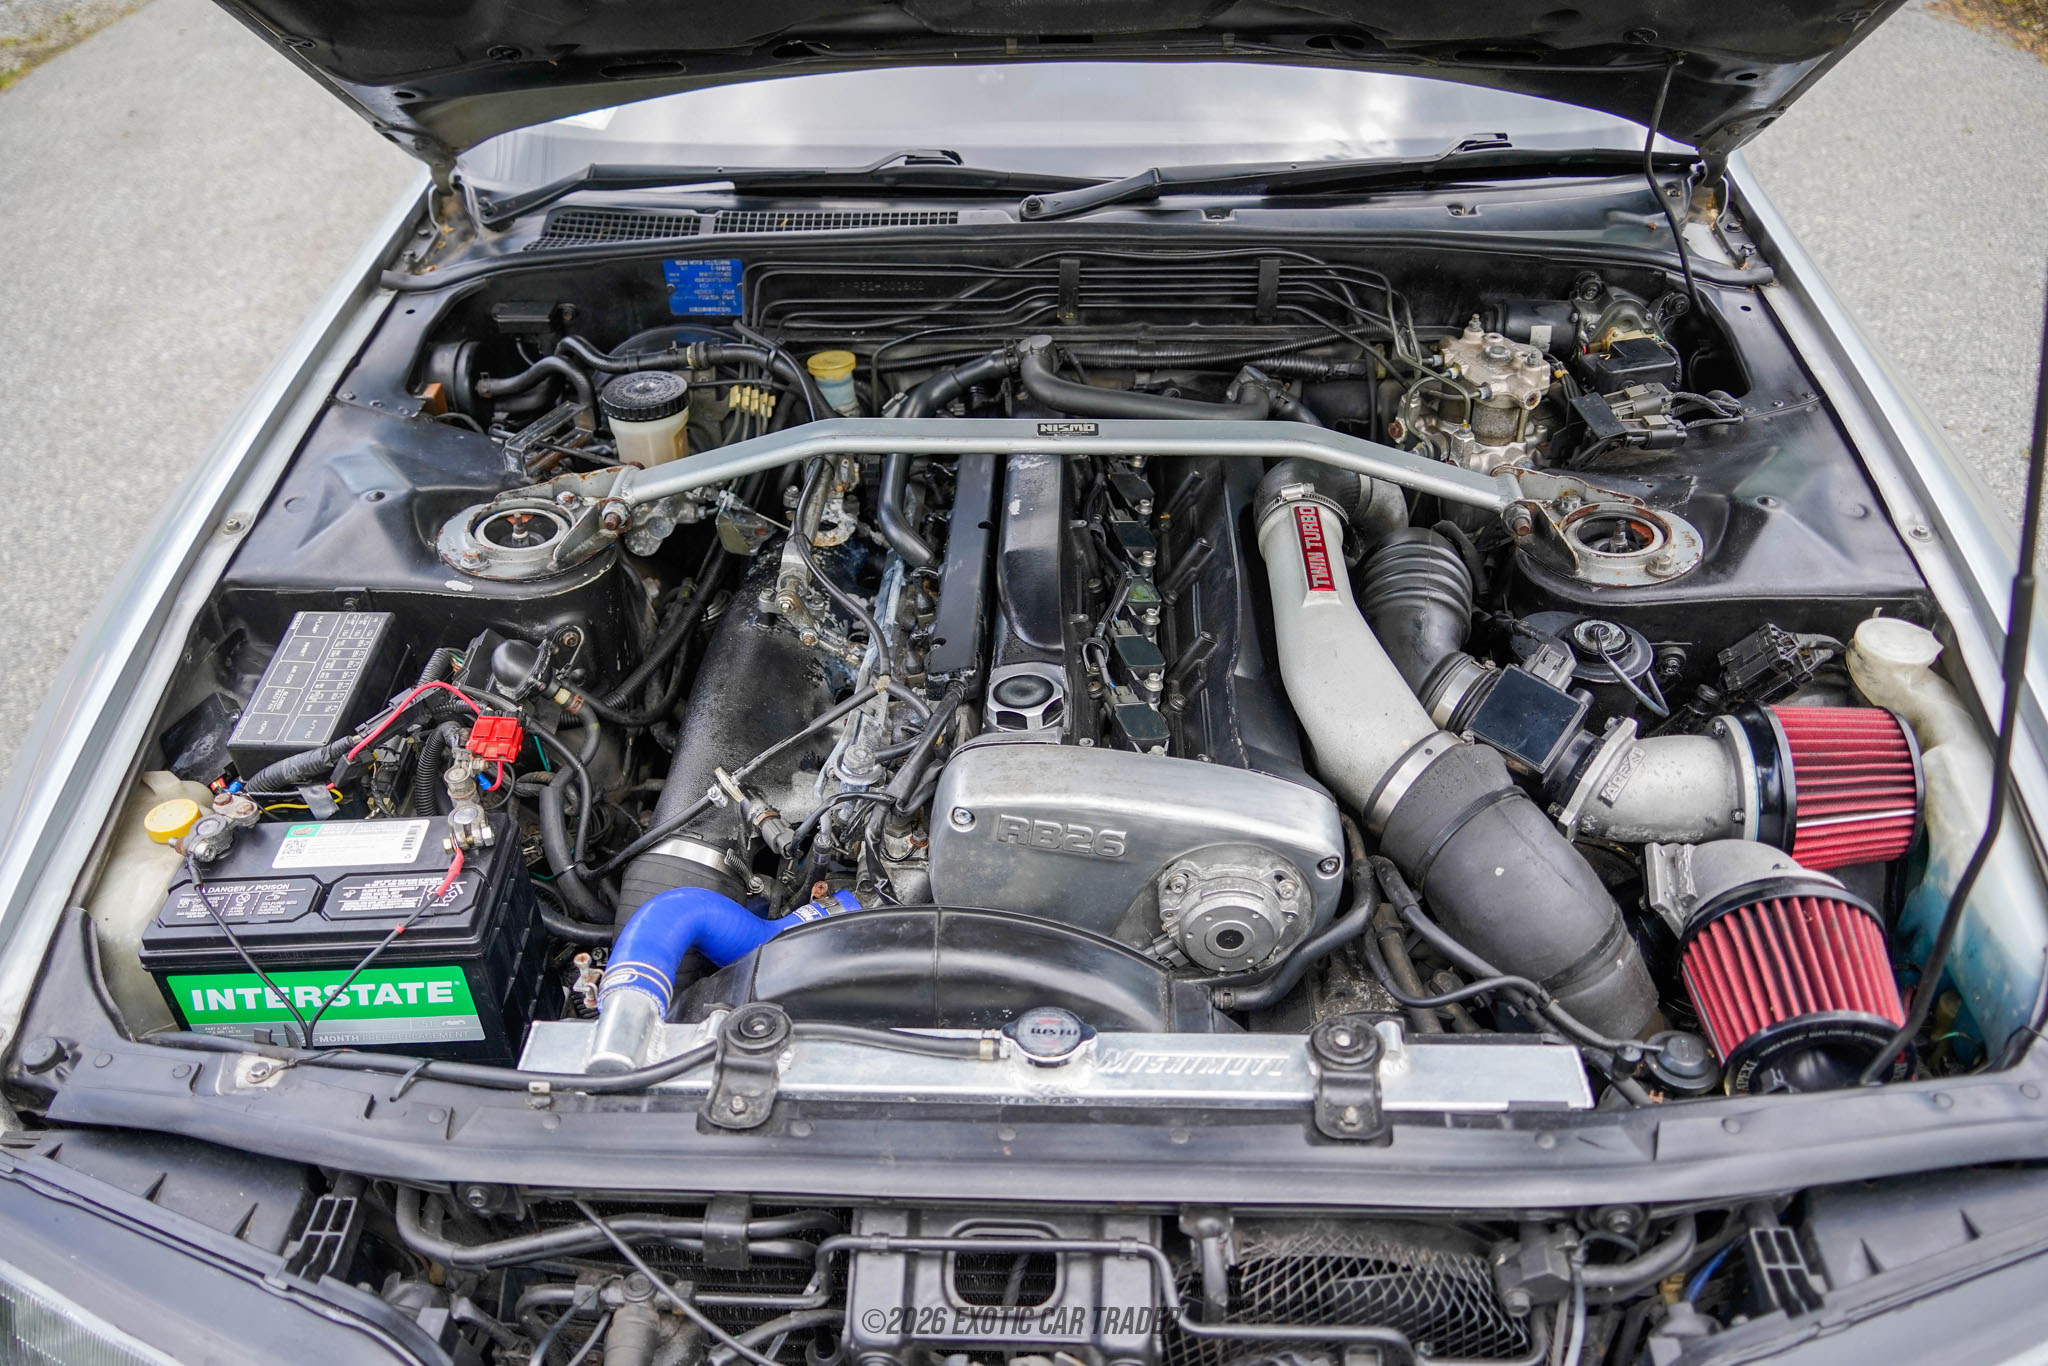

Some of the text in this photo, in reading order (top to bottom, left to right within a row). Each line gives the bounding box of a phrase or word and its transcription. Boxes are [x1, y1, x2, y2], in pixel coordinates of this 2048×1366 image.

[1040, 424, 1096, 432] NISMO
[1299, 506, 1331, 587] TWIN TURBO
[998, 814, 1128, 857] RB26
[208, 886, 246, 894] DANGER
[255, 883, 290, 891] POISON
[191, 981, 454, 1011] INTERSTATE
[301, 1030, 469, 1044] 2-MONTH FREE REPLACEMENT
[1098, 1048, 1290, 1077] MISHIMOTO
